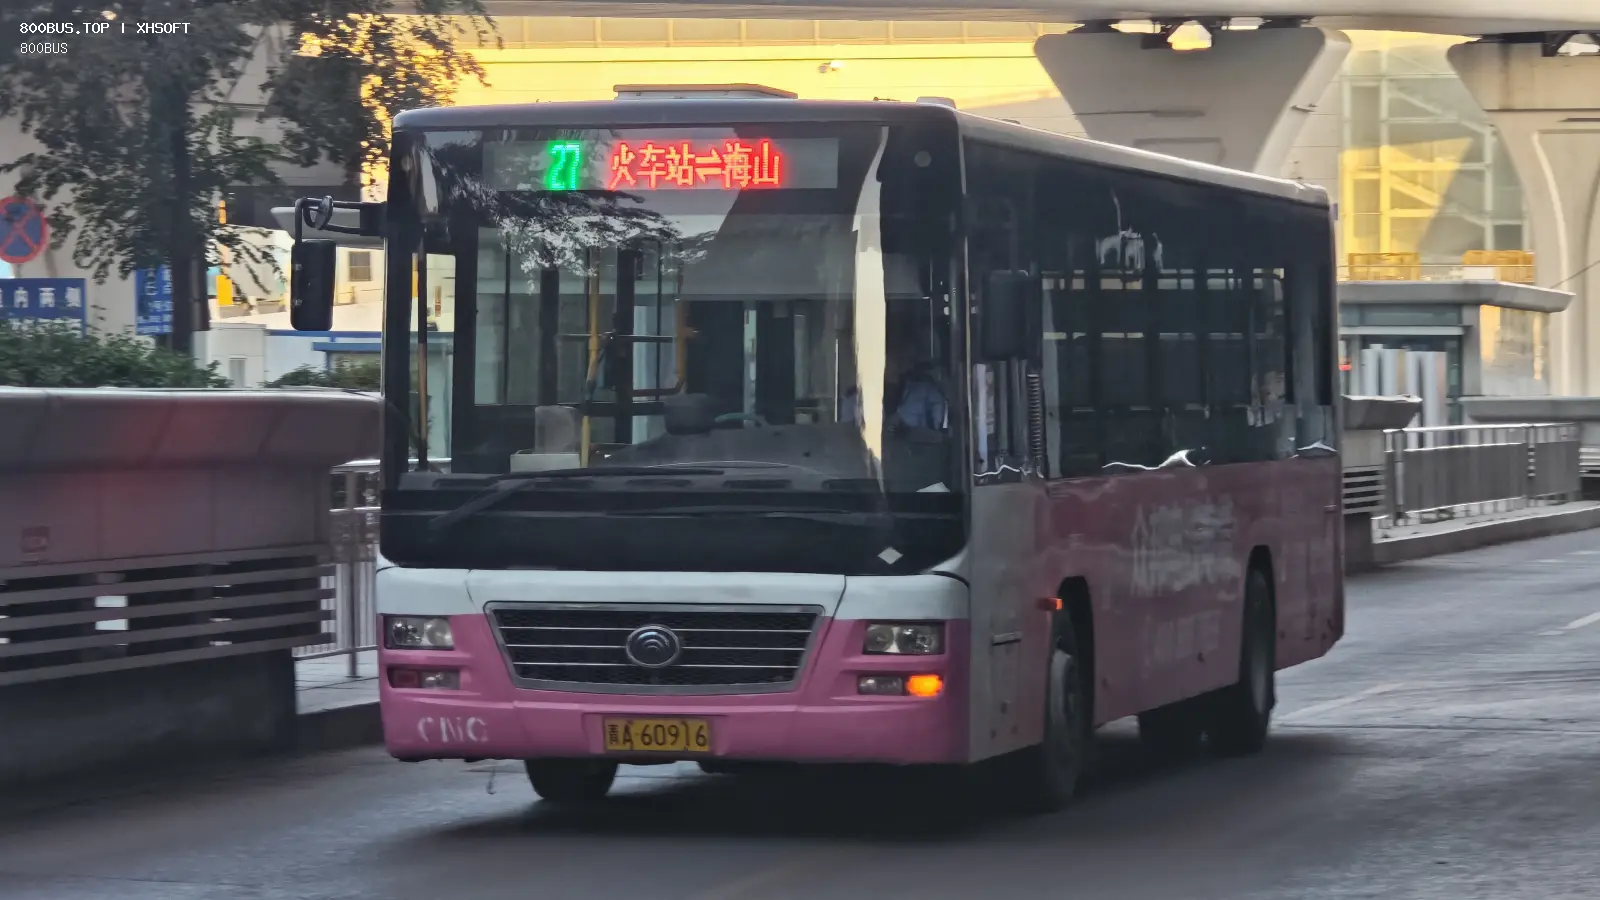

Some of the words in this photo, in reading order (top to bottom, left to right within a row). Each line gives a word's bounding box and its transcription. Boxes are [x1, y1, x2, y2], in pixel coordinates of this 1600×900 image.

[549, 142, 581, 190] 27
[609, 142, 695, 191] 火车站
[722, 141, 781, 189] 海山
